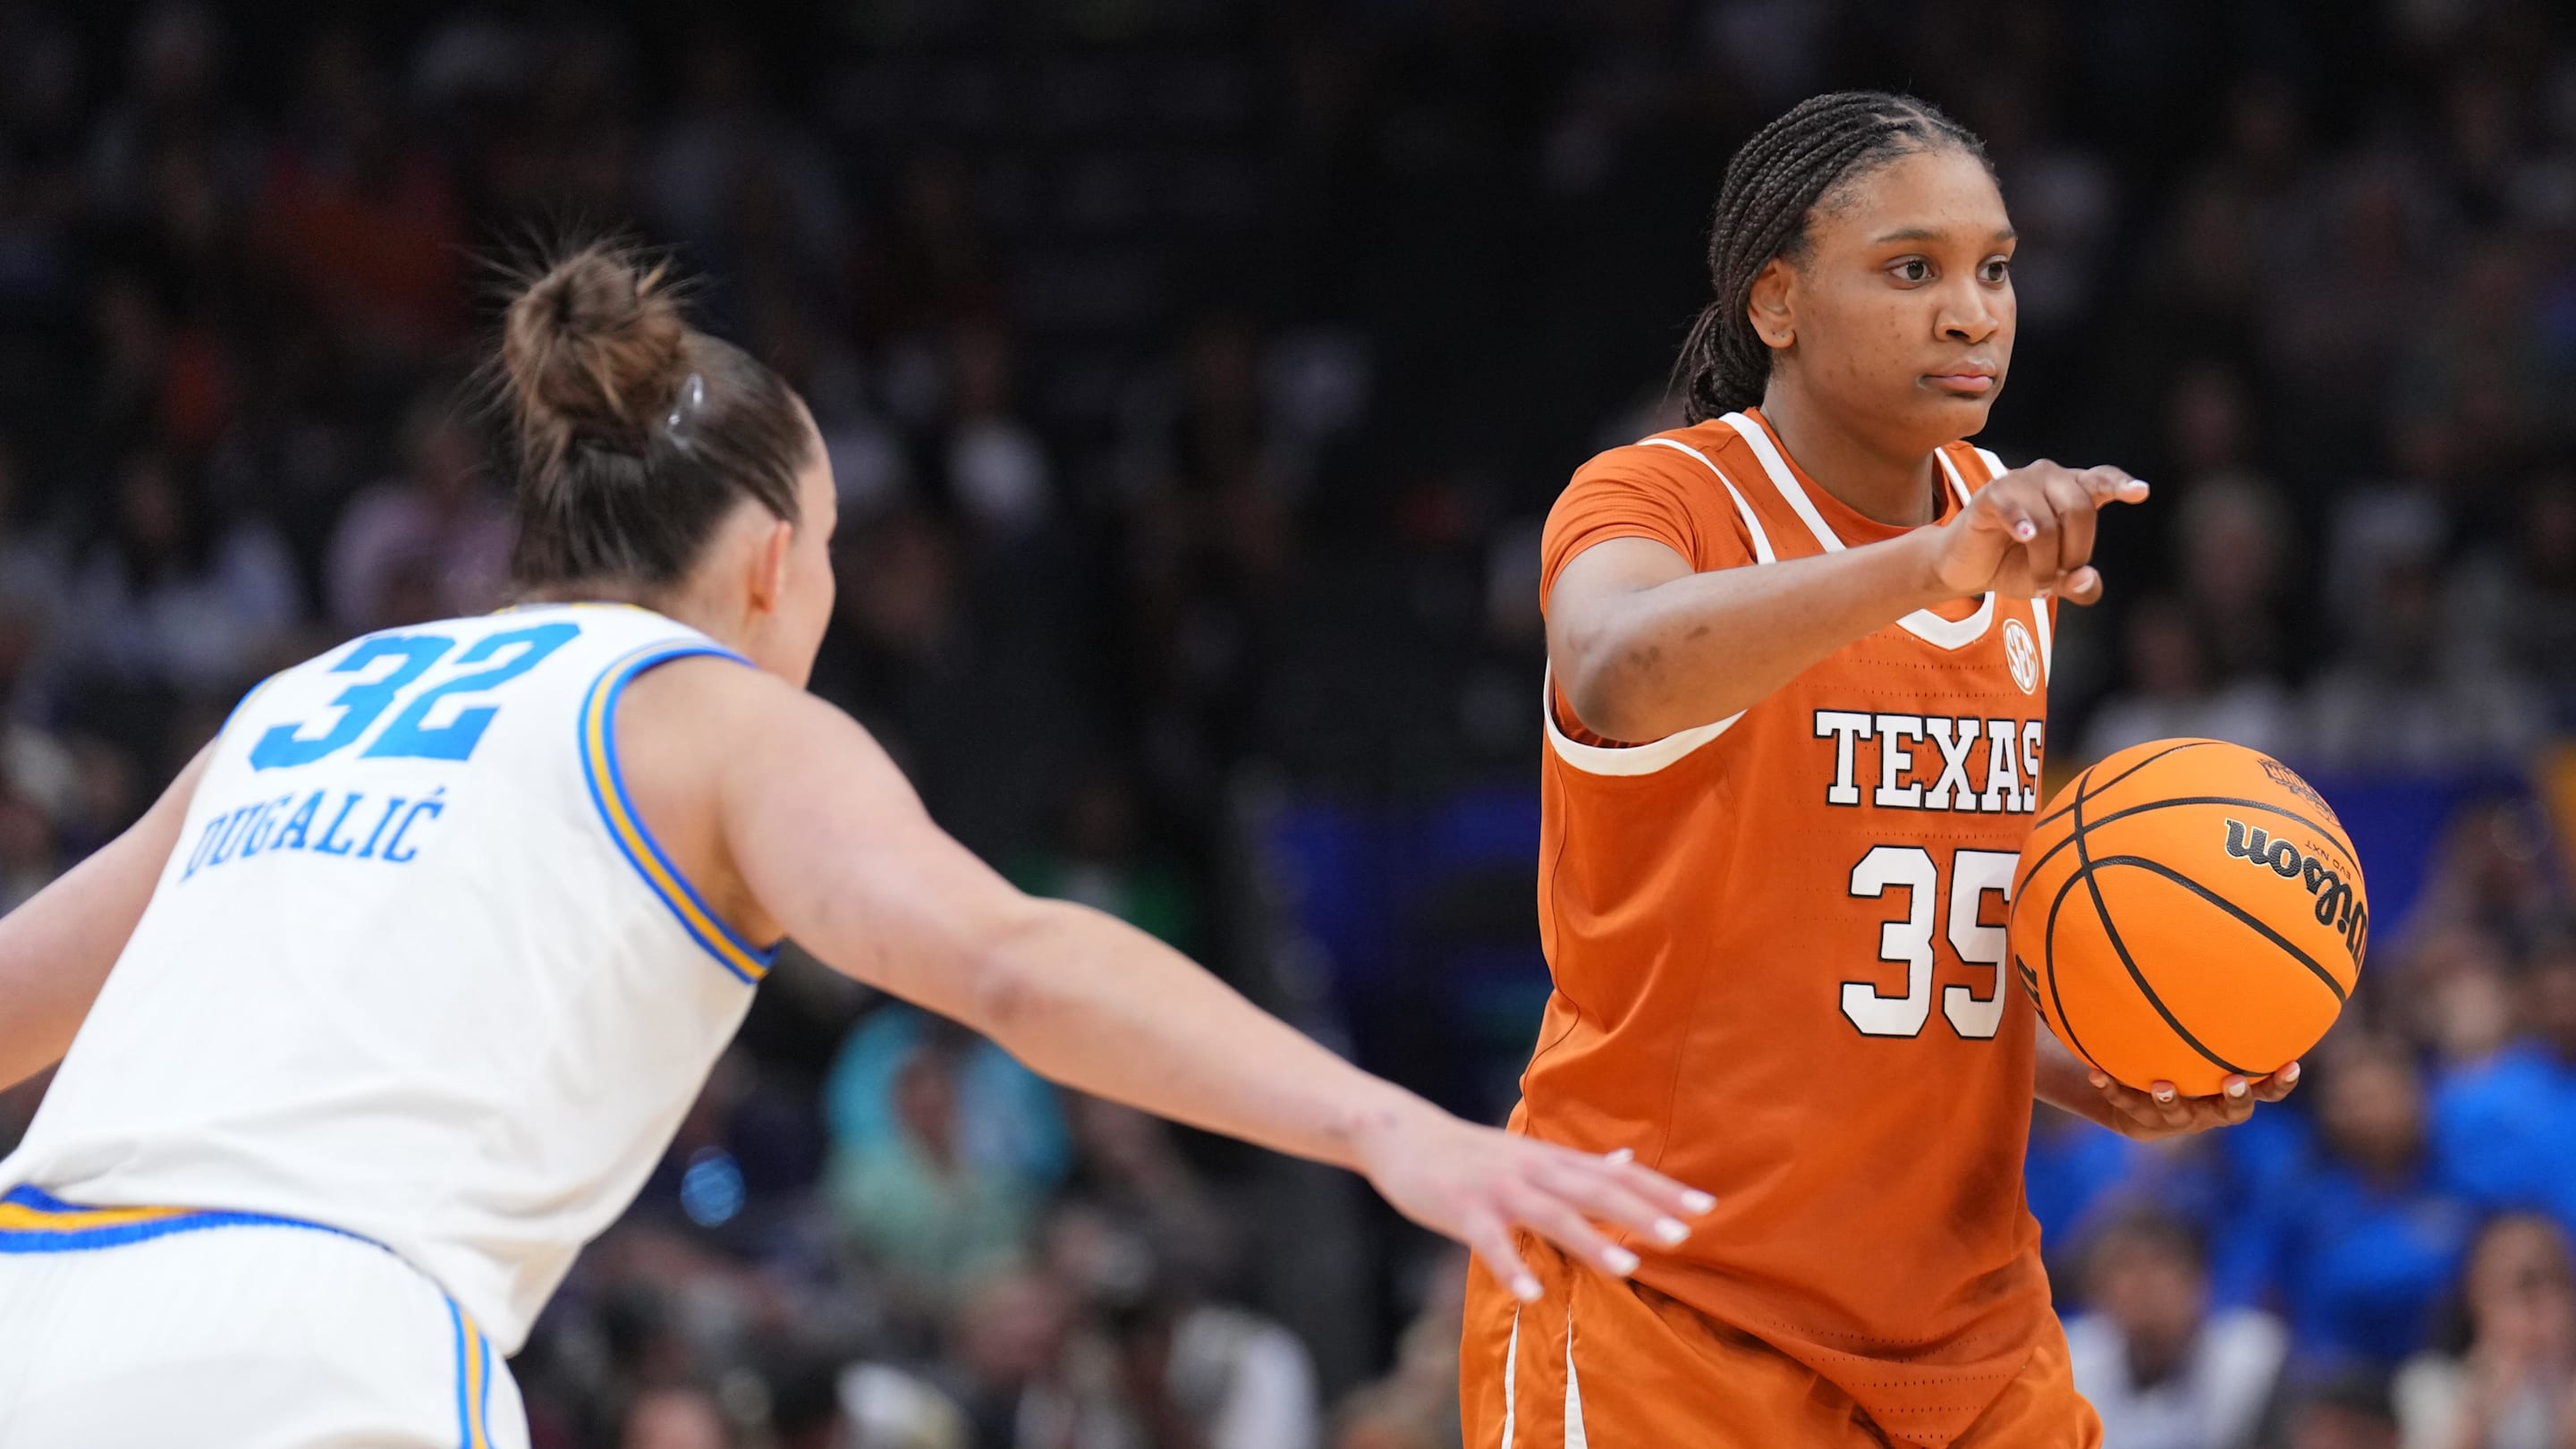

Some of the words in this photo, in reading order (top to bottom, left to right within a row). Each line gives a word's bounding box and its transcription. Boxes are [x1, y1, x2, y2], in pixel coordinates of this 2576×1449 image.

[249, 623, 581, 772] 32
[2005, 623, 2037, 690] SEC
[1813, 709, 2043, 814] TEXAS
[182, 787, 445, 882] DUGALIĆ
[2305, 841, 2329, 861] NXT
[1839, 845, 2021, 1039] 35
